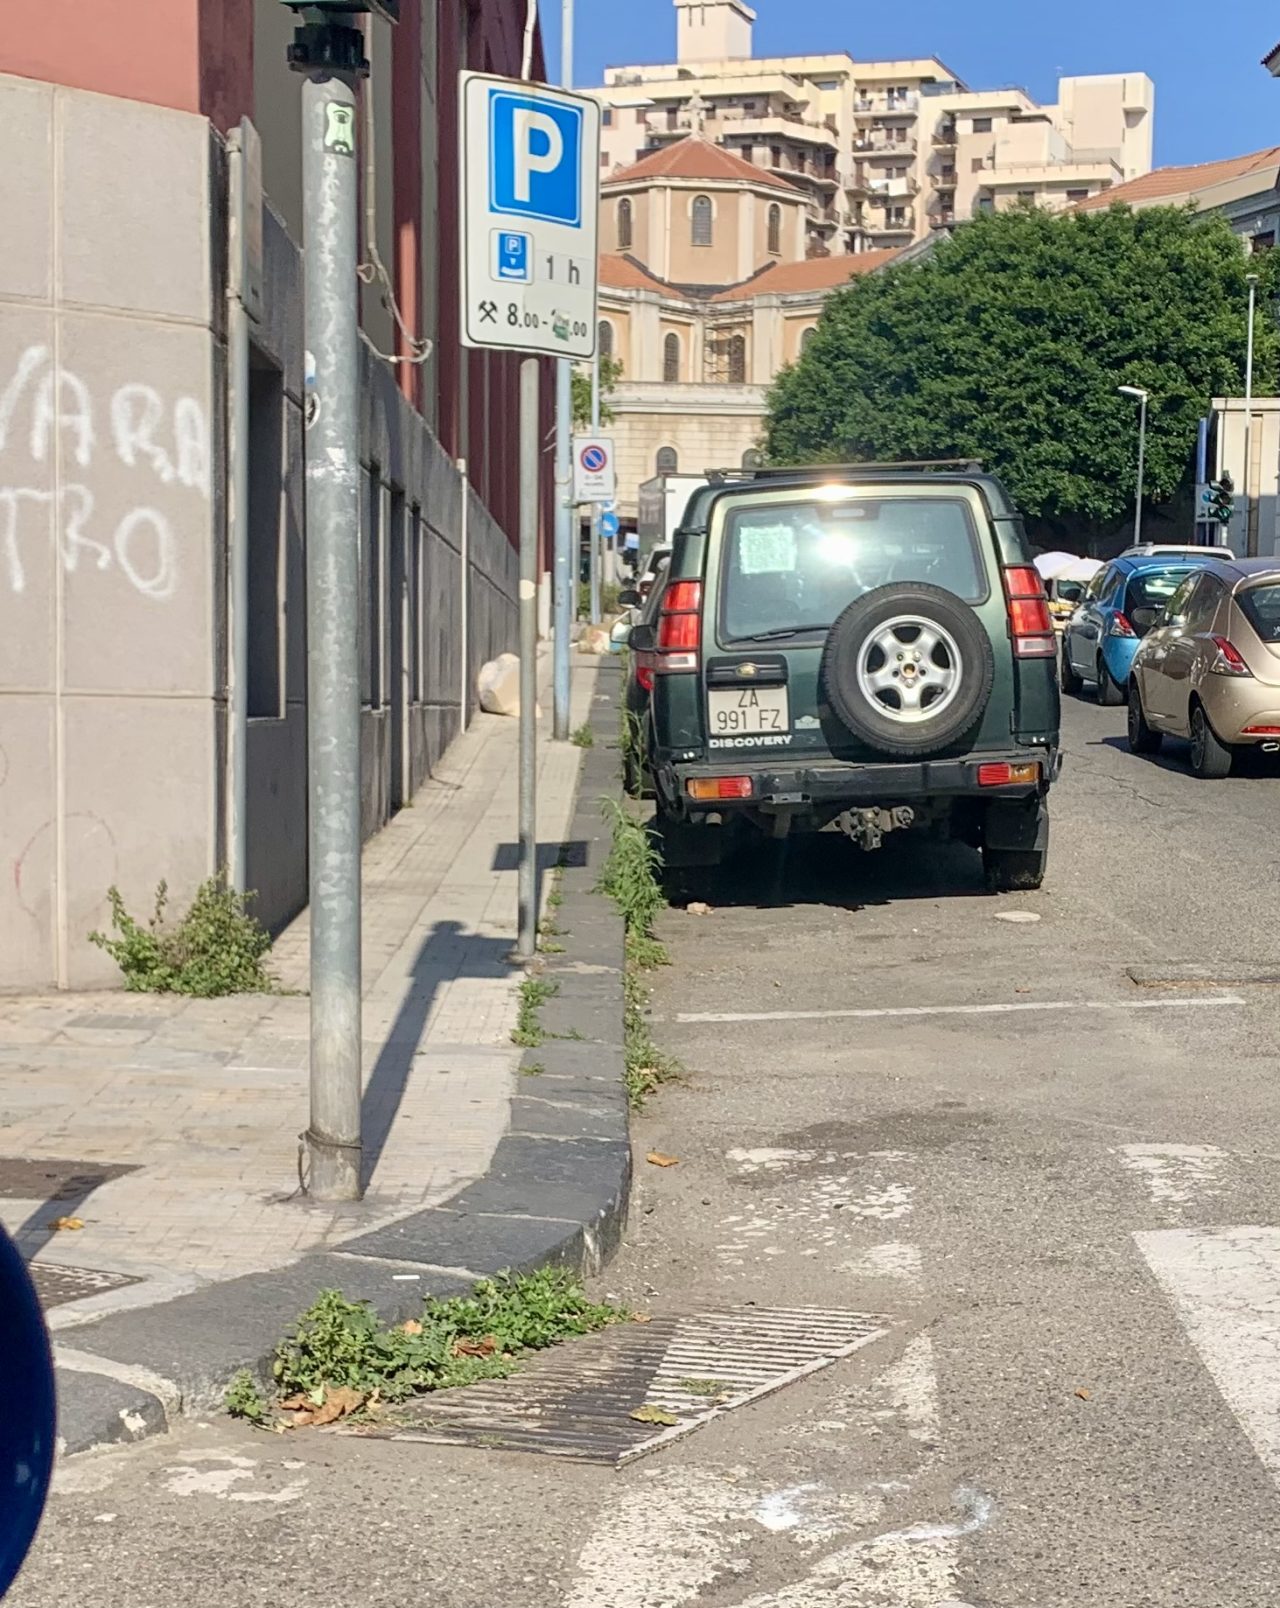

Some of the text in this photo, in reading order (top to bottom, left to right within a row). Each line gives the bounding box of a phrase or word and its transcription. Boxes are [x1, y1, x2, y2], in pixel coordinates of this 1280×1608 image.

[513, 107, 564, 203] P
[738, 688, 760, 708] ZA
[717, 709, 782, 731] 991 FZ
[708, 735, 793, 749] DISCOVERY
